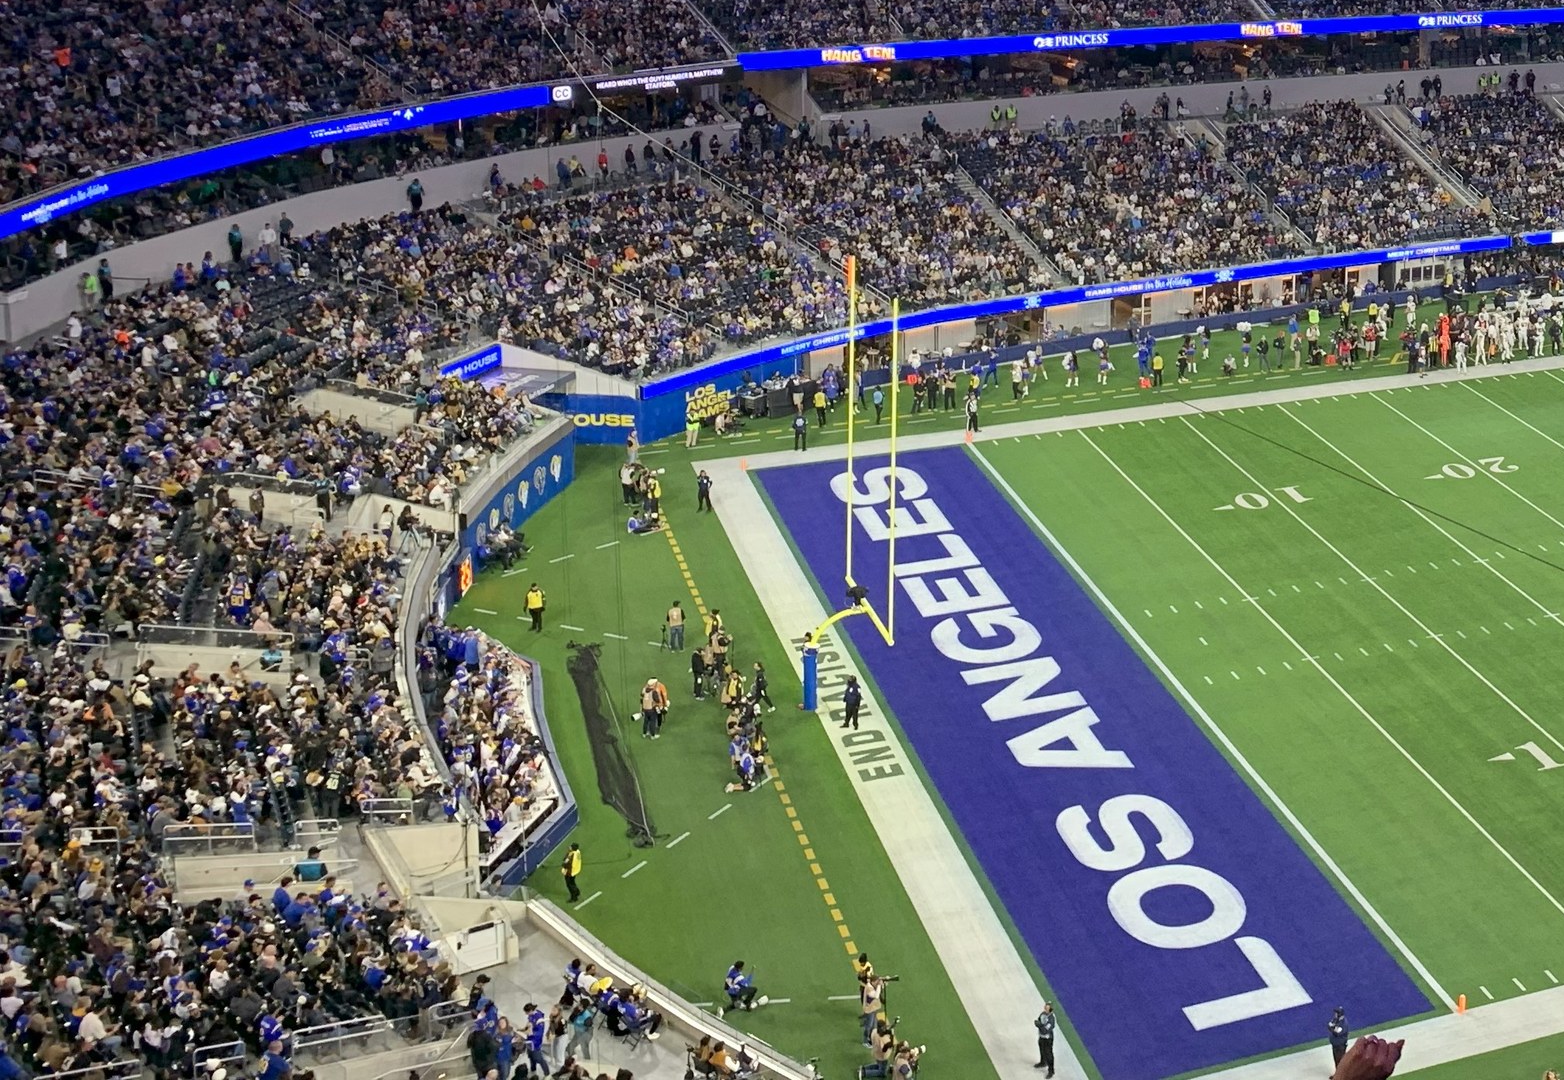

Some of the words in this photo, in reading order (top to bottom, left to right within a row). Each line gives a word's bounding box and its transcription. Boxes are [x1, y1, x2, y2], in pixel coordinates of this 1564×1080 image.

[1437, 14, 1482, 25] PRINCESS
[1241, 23, 1273, 36] HANG
[1055, 33, 1109, 47] PRINCESS
[821, 48, 862, 63] HANG
[637, 77, 648, 85] THE
[1386, 248, 1414, 258] MERRY
[1415, 243, 1461, 255] CHRISTMAS
[1084, 287, 1112, 298] RAMS
[1113, 283, 1144, 294] HOUSE
[780, 340, 811, 356] MERRY
[464, 351, 498, 374] HOUSE
[685, 383, 716, 400] LOS
[567, 413, 635, 428] OUSE
[1441, 455, 1519, 480] 20
[1233, 484, 1314, 512] 10
[829, 463, 1136, 770] ANGELES
[840, 729, 905, 783] END
[1056, 792, 1313, 1032] LOS
